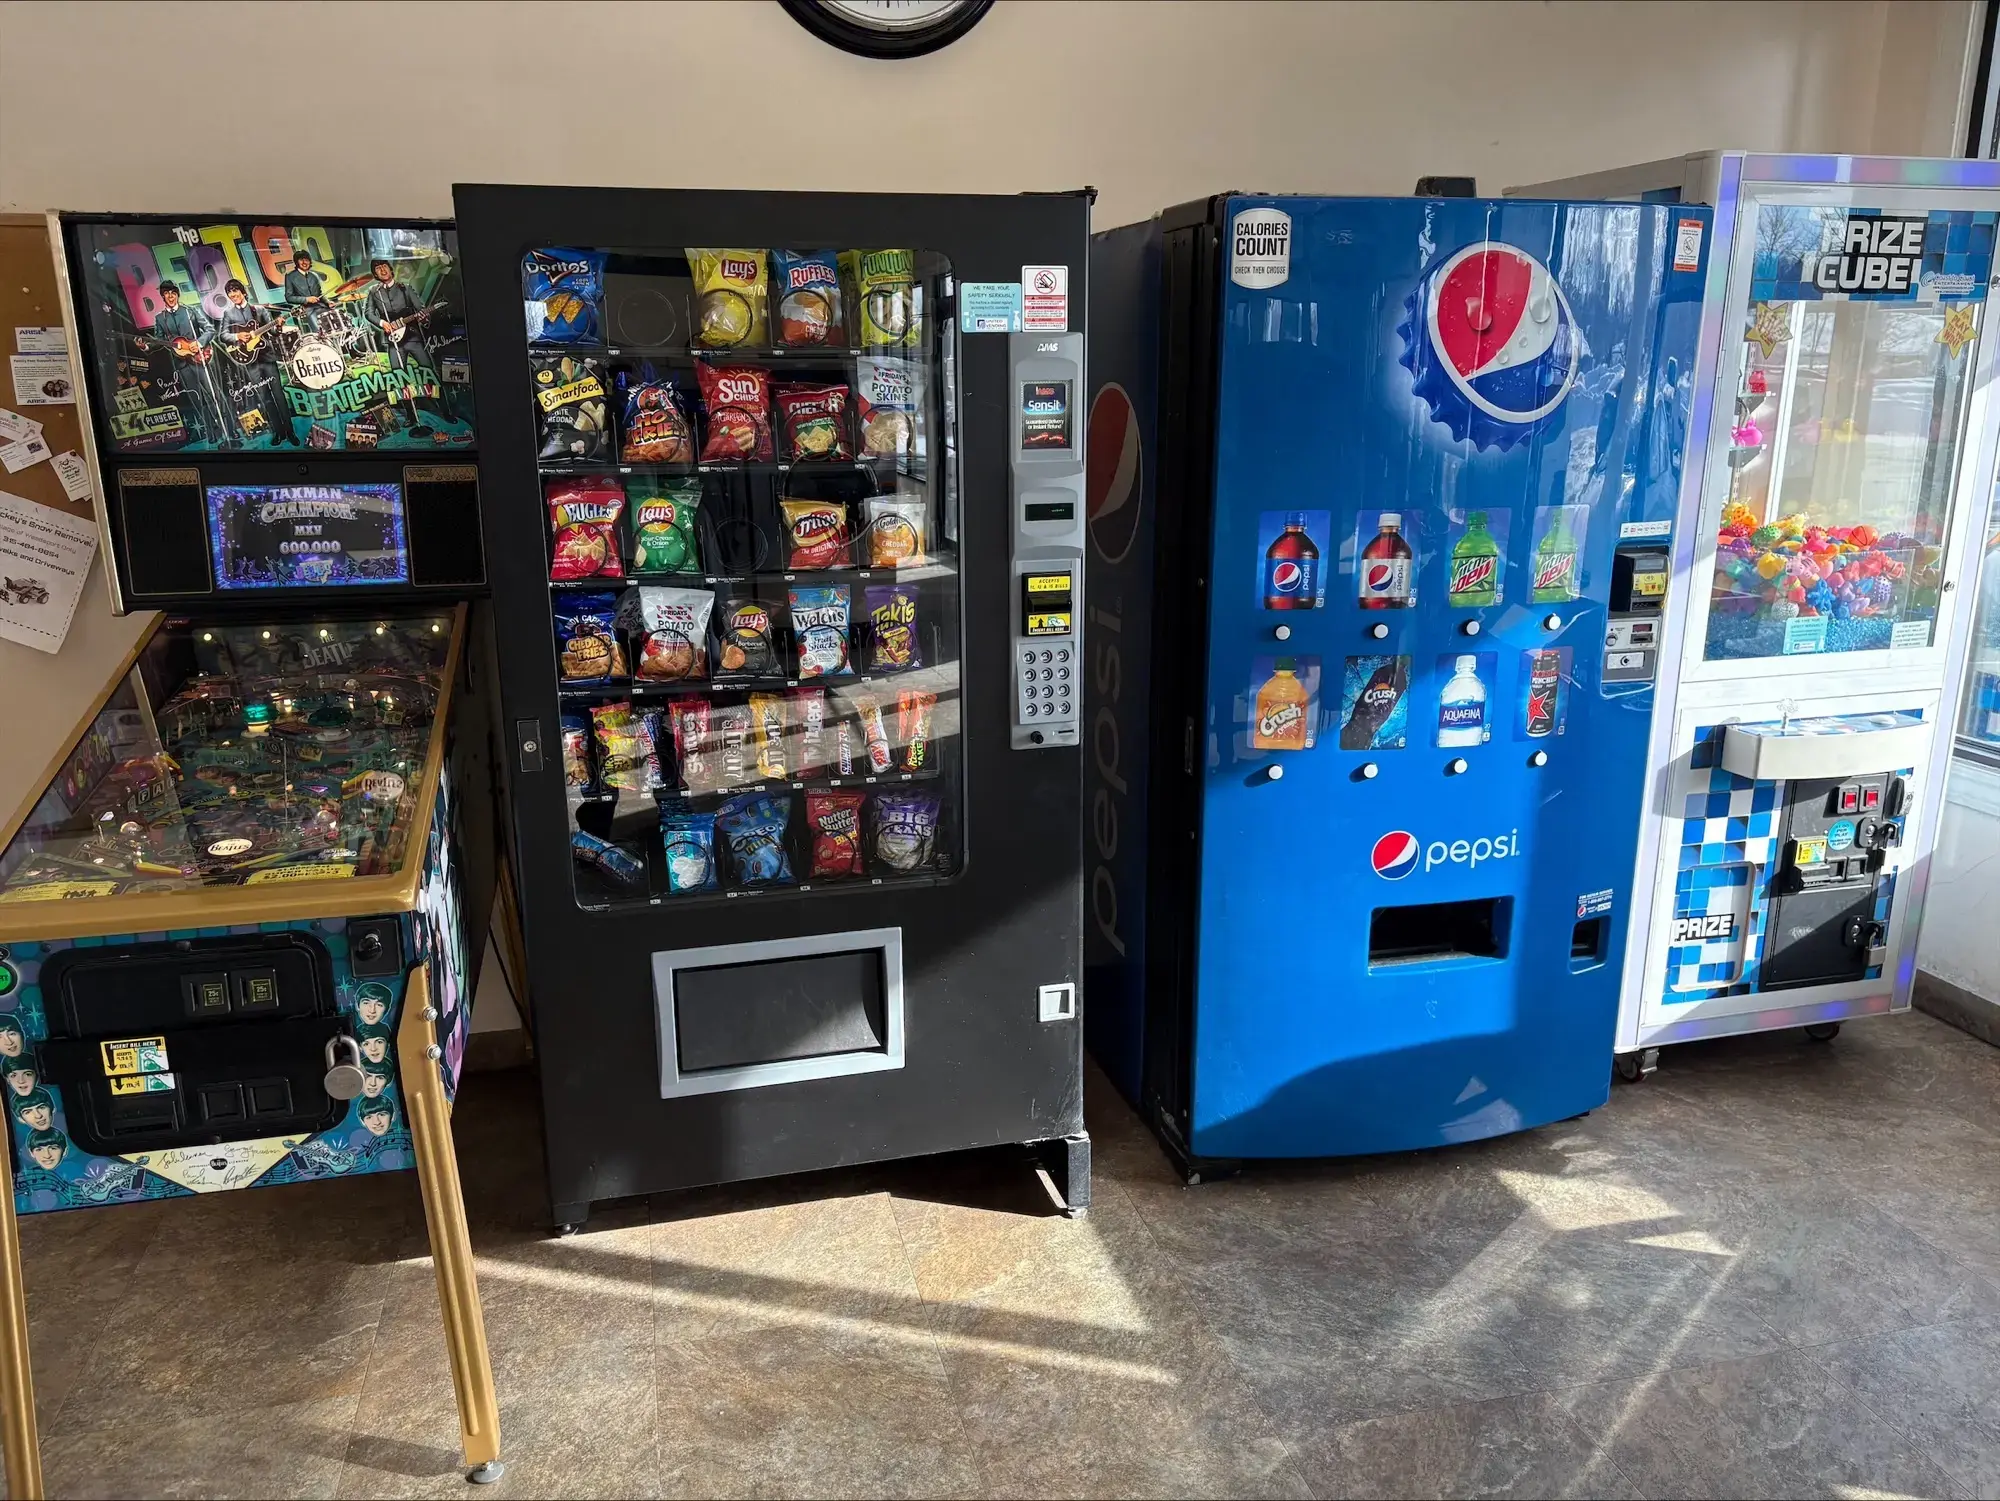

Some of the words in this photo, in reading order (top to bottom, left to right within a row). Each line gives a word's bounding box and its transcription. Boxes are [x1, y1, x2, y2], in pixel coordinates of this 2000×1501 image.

[172, 225, 199, 246] The
[1237, 223, 1288, 236] CALORIES
[1842, 221, 1925, 254] RIZE
[525, 260, 590, 274] Doritos
[722, 258, 756, 280] Lay's
[1235, 266, 1250, 274] CHECK
[1253, 266, 1265, 274] THEN
[1267, 266, 1286, 274] CHOOSE
[1816, 256, 1911, 290] CUBE
[789, 264, 836, 289] RUFFLES
[1037, 343, 1058, 351] AMS
[296, 359, 342, 378] BEATLES
[543, 382, 600, 407] Smartfood
[718, 377, 760, 402] Sun
[872, 382, 913, 394] POTATO
[733, 394, 760, 402] CHIPS
[876, 392, 908, 402] SKINS
[1028, 400, 1061, 411] Sensit
[145, 411, 179, 427] PLAYERS
[134, 438, 152, 448] Game
[269, 487, 342, 500] TAXMAN
[640, 506, 673, 524] Lay's
[28, 521, 53, 534] Snow
[796, 511, 838, 537] Fritos
[19, 553, 34, 563] and
[1302, 565, 1311, 591] pepsi
[1397, 564, 1405, 591] pepsi
[734, 612, 768, 628] Lay's
[795, 610, 845, 628] Welch's
[872, 601, 915, 626] Takis
[658, 620, 694, 631] POTATO
[568, 636, 612, 650] CHEDDAR
[662, 630, 690, 640] SKINS
[808, 642, 838, 650] Snacks
[577, 648, 608, 662] FRIES
[1364, 687, 1397, 703] Crush
[1260, 703, 1303, 736] Crush
[1443, 708, 1481, 722] AQUAFINA
[1091, 605, 1127, 957] pepsi
[818, 809, 852, 828] Nutter
[888, 811, 930, 825] BIG
[732, 822, 786, 851] OREO
[1425, 828, 1518, 873] pepsi
[1674, 916, 1732, 940] PRIZE
